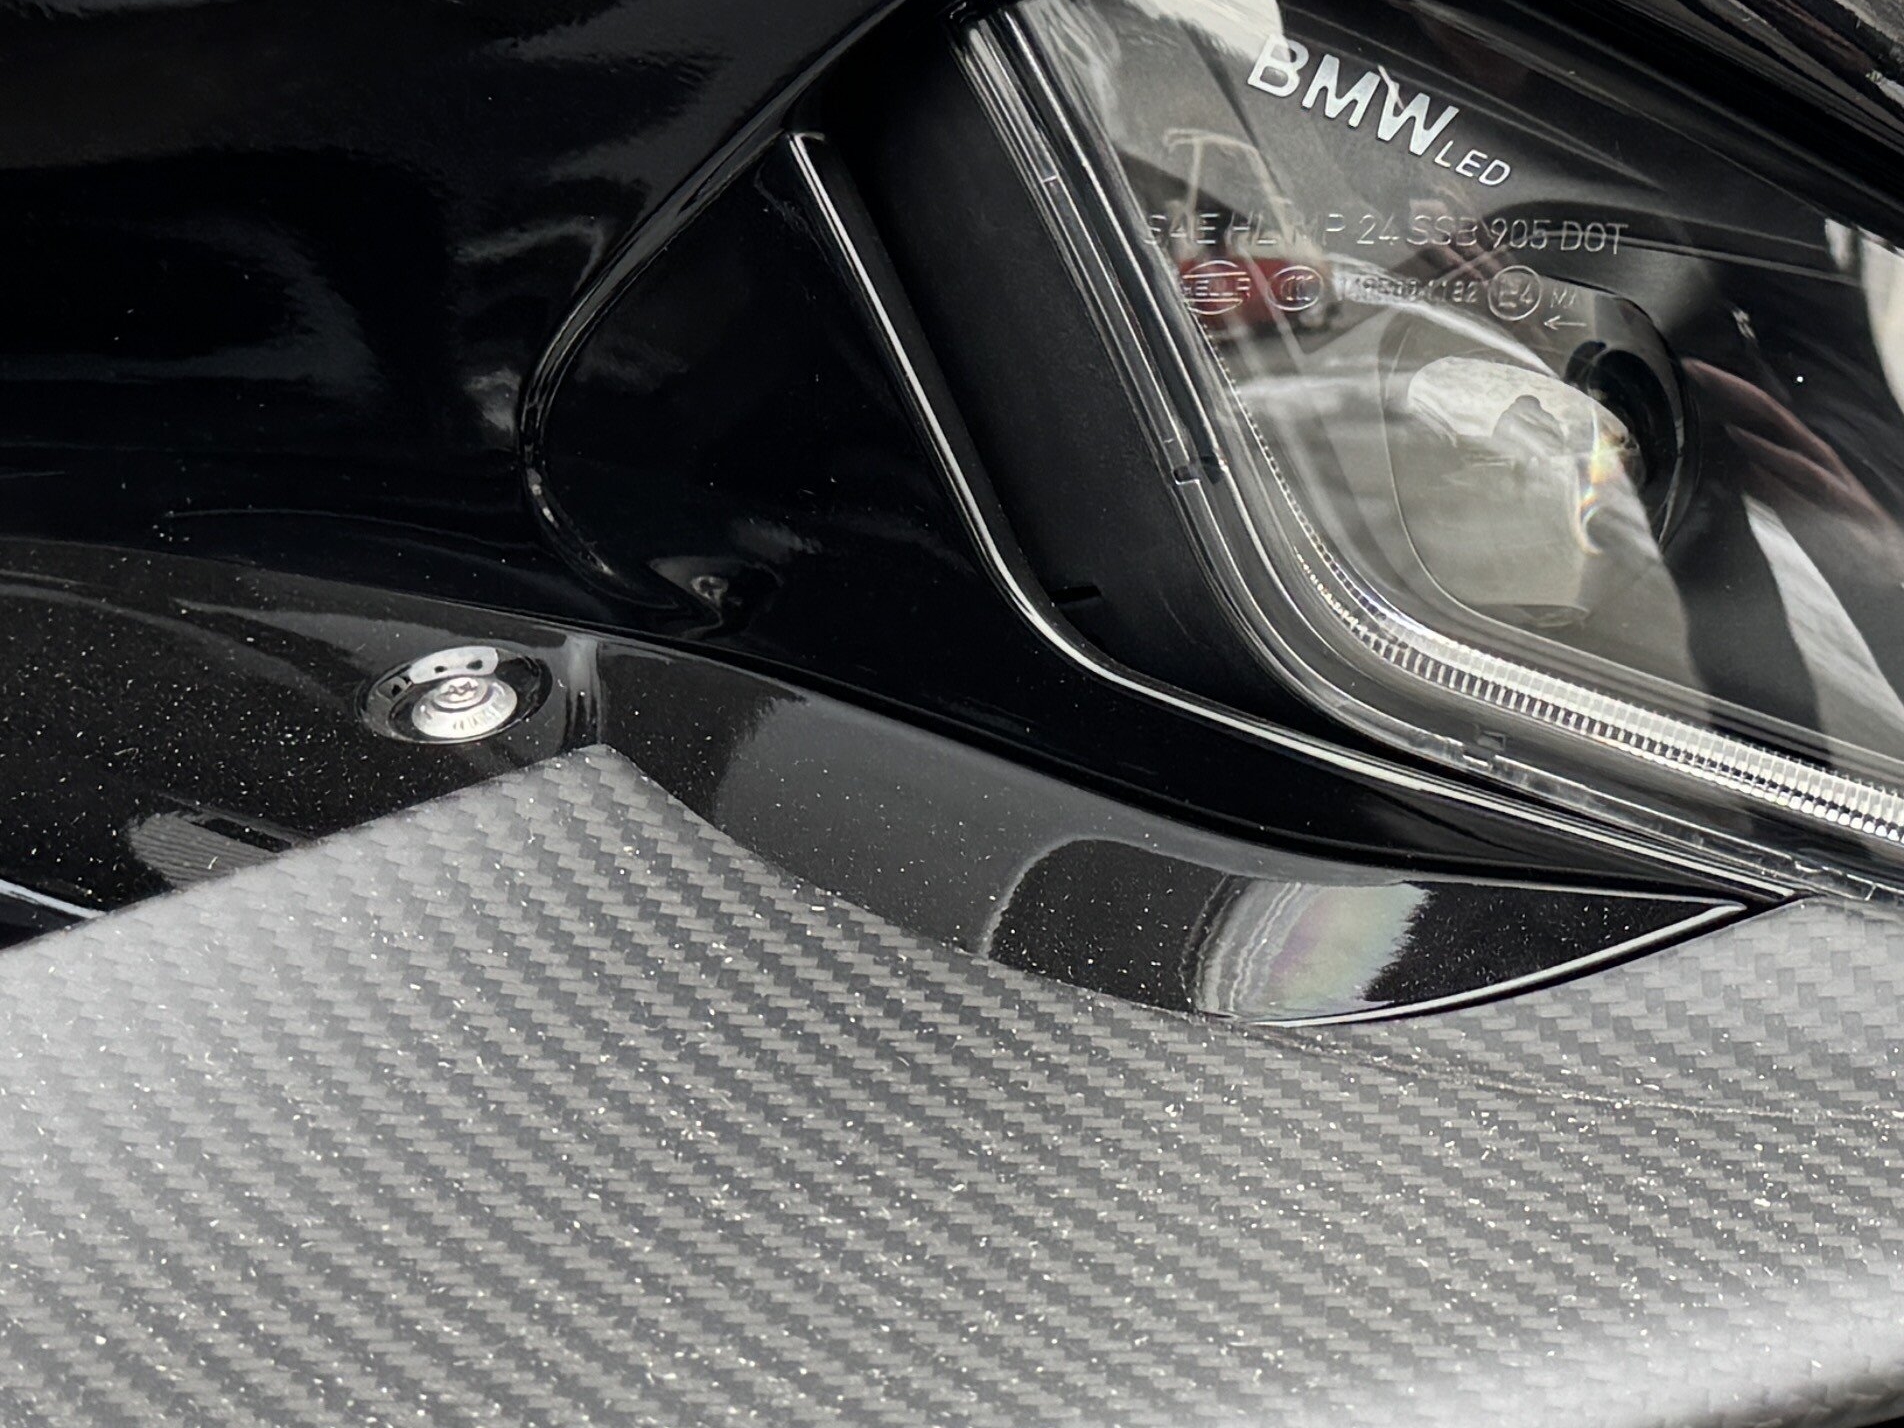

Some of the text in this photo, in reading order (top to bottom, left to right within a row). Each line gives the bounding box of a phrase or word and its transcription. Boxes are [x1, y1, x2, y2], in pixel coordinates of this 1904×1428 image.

[1247, 36, 1512, 187] BMW LED
[1491, 218, 1551, 250] 905
[1560, 221, 1629, 255] DOT
